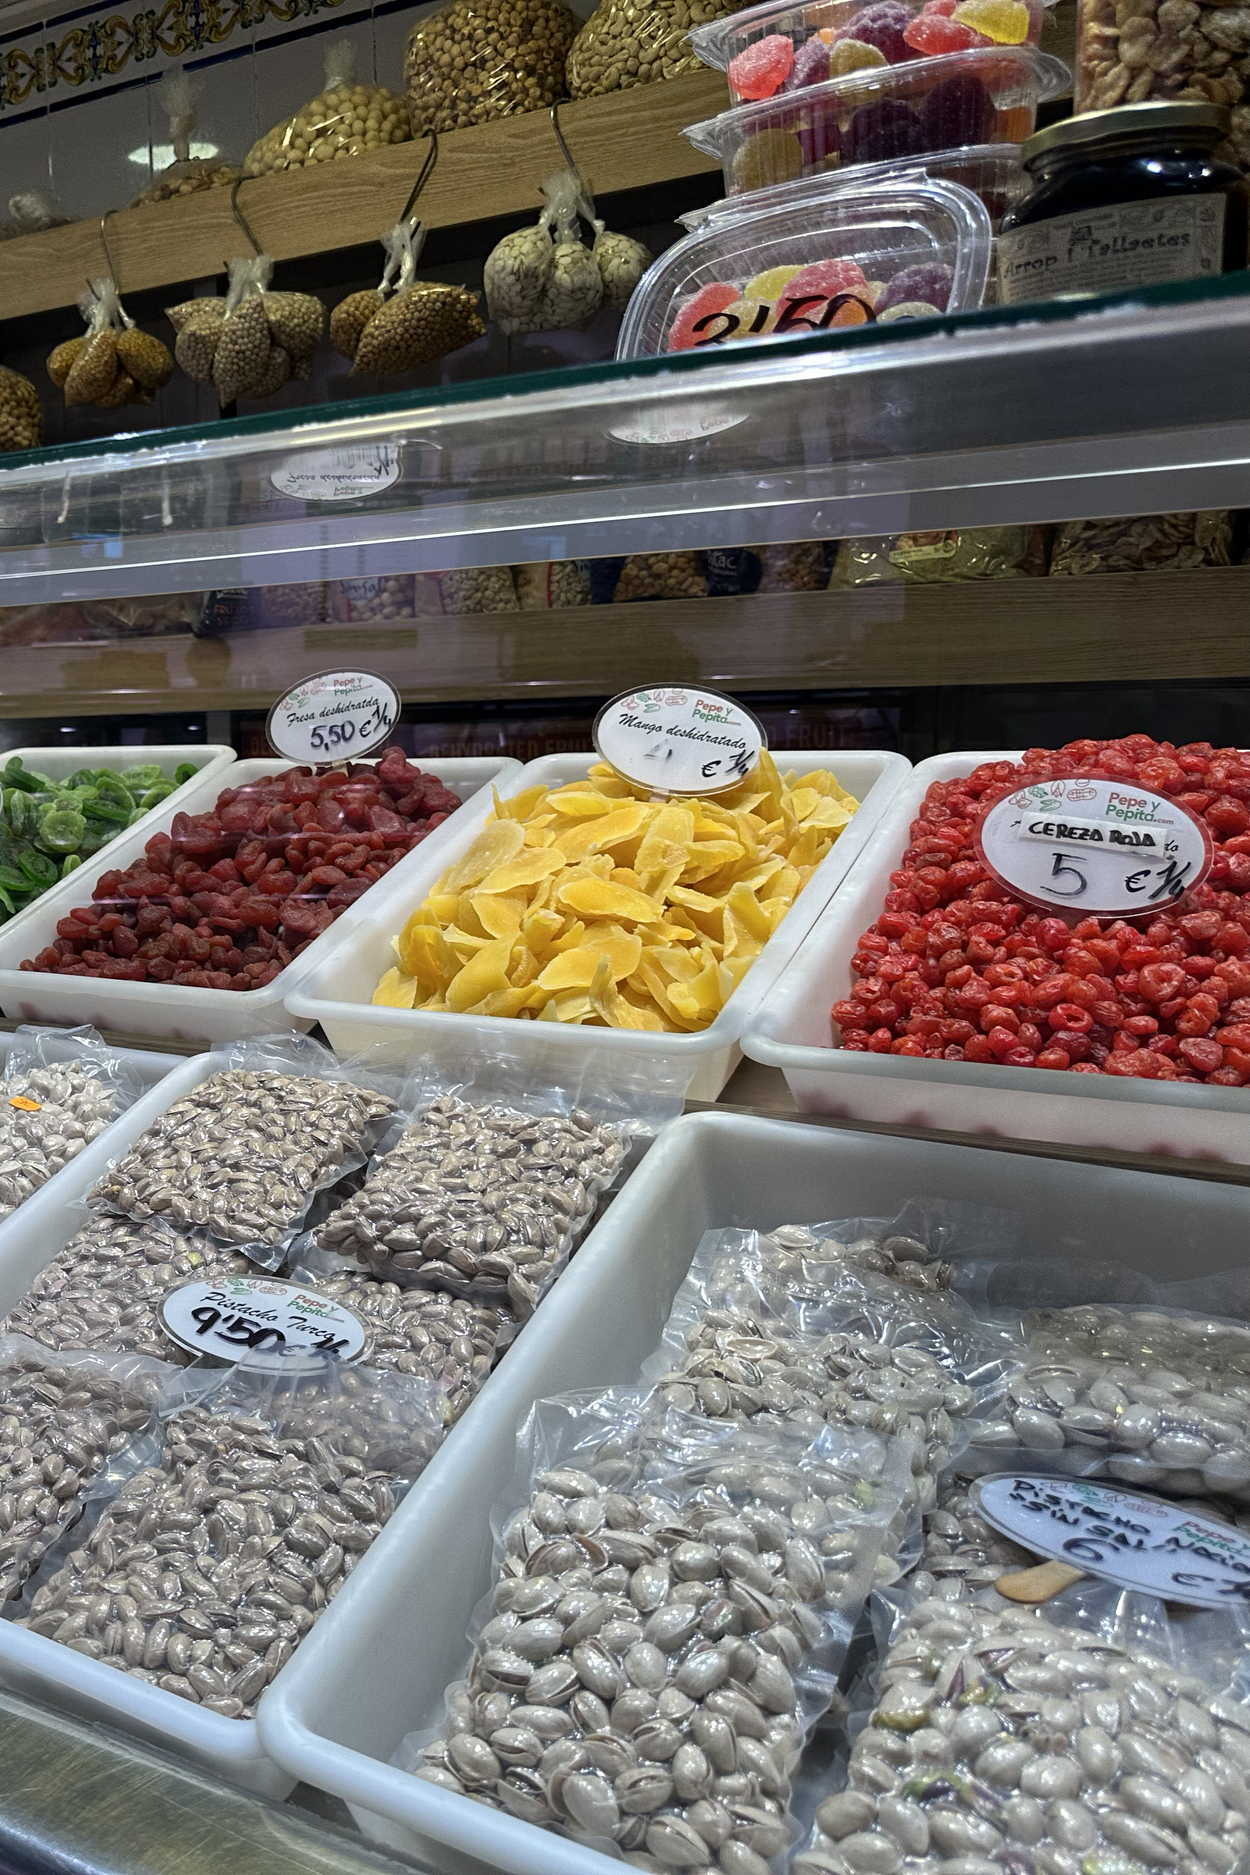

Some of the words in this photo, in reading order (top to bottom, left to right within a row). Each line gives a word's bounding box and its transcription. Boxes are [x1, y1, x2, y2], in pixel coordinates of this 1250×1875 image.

[333, 677, 355, 688] Pepe
[695, 699, 724, 714] Pepe
[286, 712, 316, 727] Fresa
[618, 713, 663, 735] Mango
[666, 724, 747, 749] deshidratado
[1108, 792, 1147, 809] Pepe
[1028, 820, 1104, 842] CEREZA
[1040, 852, 1088, 897] 5
[200, 1291, 279, 1322] Pistacho
[294, 1293, 328, 1309] Pepe
[1180, 1520, 1237, 1543] Pepe
